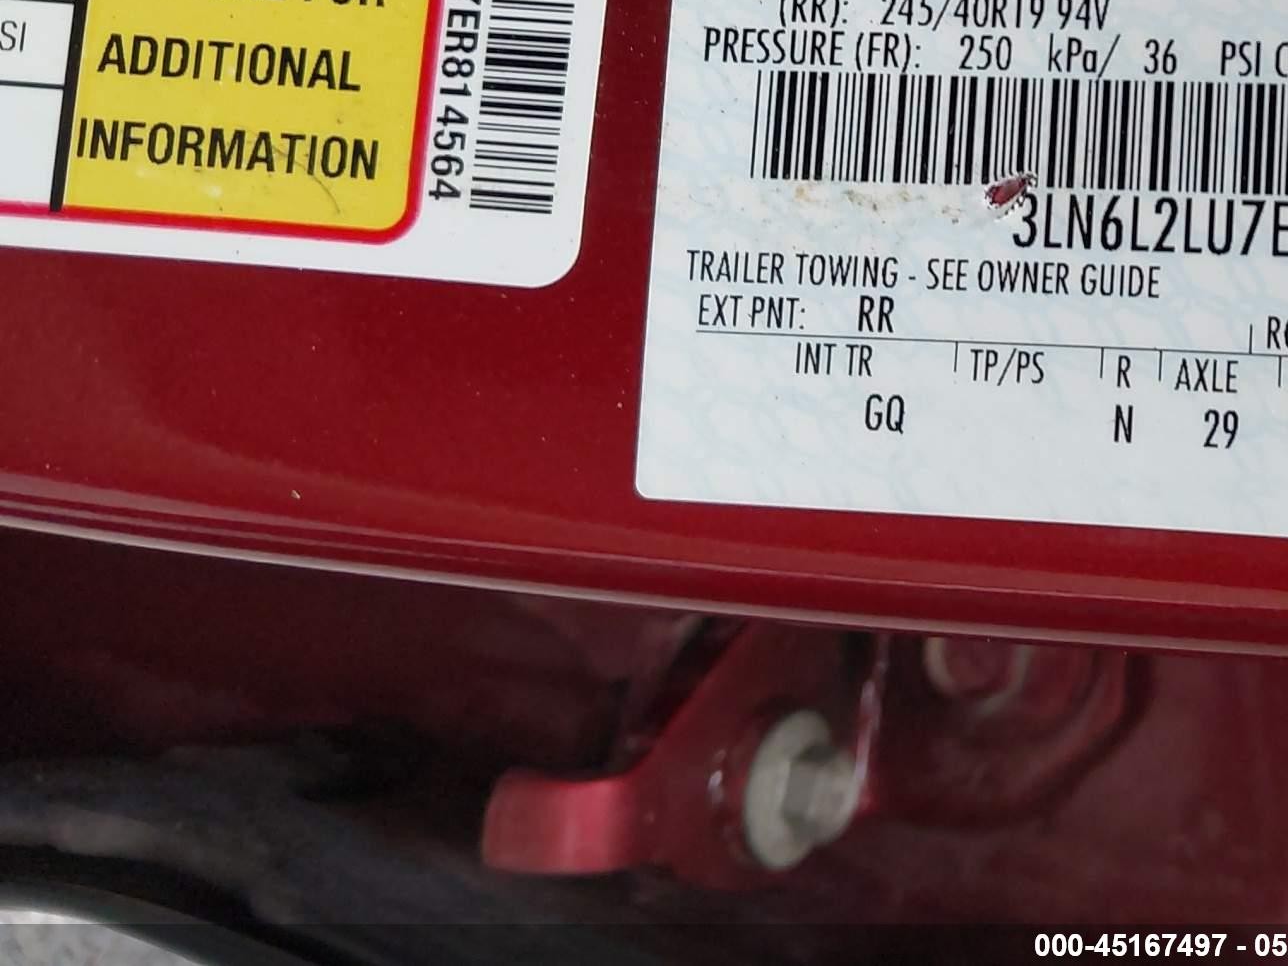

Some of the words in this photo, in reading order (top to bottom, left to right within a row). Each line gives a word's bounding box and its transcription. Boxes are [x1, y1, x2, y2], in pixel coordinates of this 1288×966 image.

[97, 34, 360, 91] ADDITIONAL
[704, 26, 845, 66] PRESSURE
[855, 32, 920, 74] (FR):
[959, 35, 1012, 70] 250
[1048, 33, 1120, 79] kPa/
[1144, 39, 1177, 75] 36
[1221, 41, 1261, 77] PSI
[77, 118, 378, 180] INFORMATION
[687, 250, 784, 284] TRAILER
[796, 253, 898, 288] TOWING
[927, 259, 969, 291] SEE
[978, 260, 1069, 294] OWNER
[1081, 264, 1160, 298] GUIDE
[699, 294, 743, 327] EXT
[748, 296, 805, 329] PNT:
[858, 295, 894, 333] RR
[796, 342, 837, 375] INT
[846, 344, 872, 377] TR
[971, 348, 1044, 386] TP/PS
[1117, 355, 1131, 388] R
[1175, 358, 1238, 393] AXLE
[865, 394, 904, 434] GQ
[1114, 405, 1133, 443] N
[1204, 409, 1238, 448] 29
